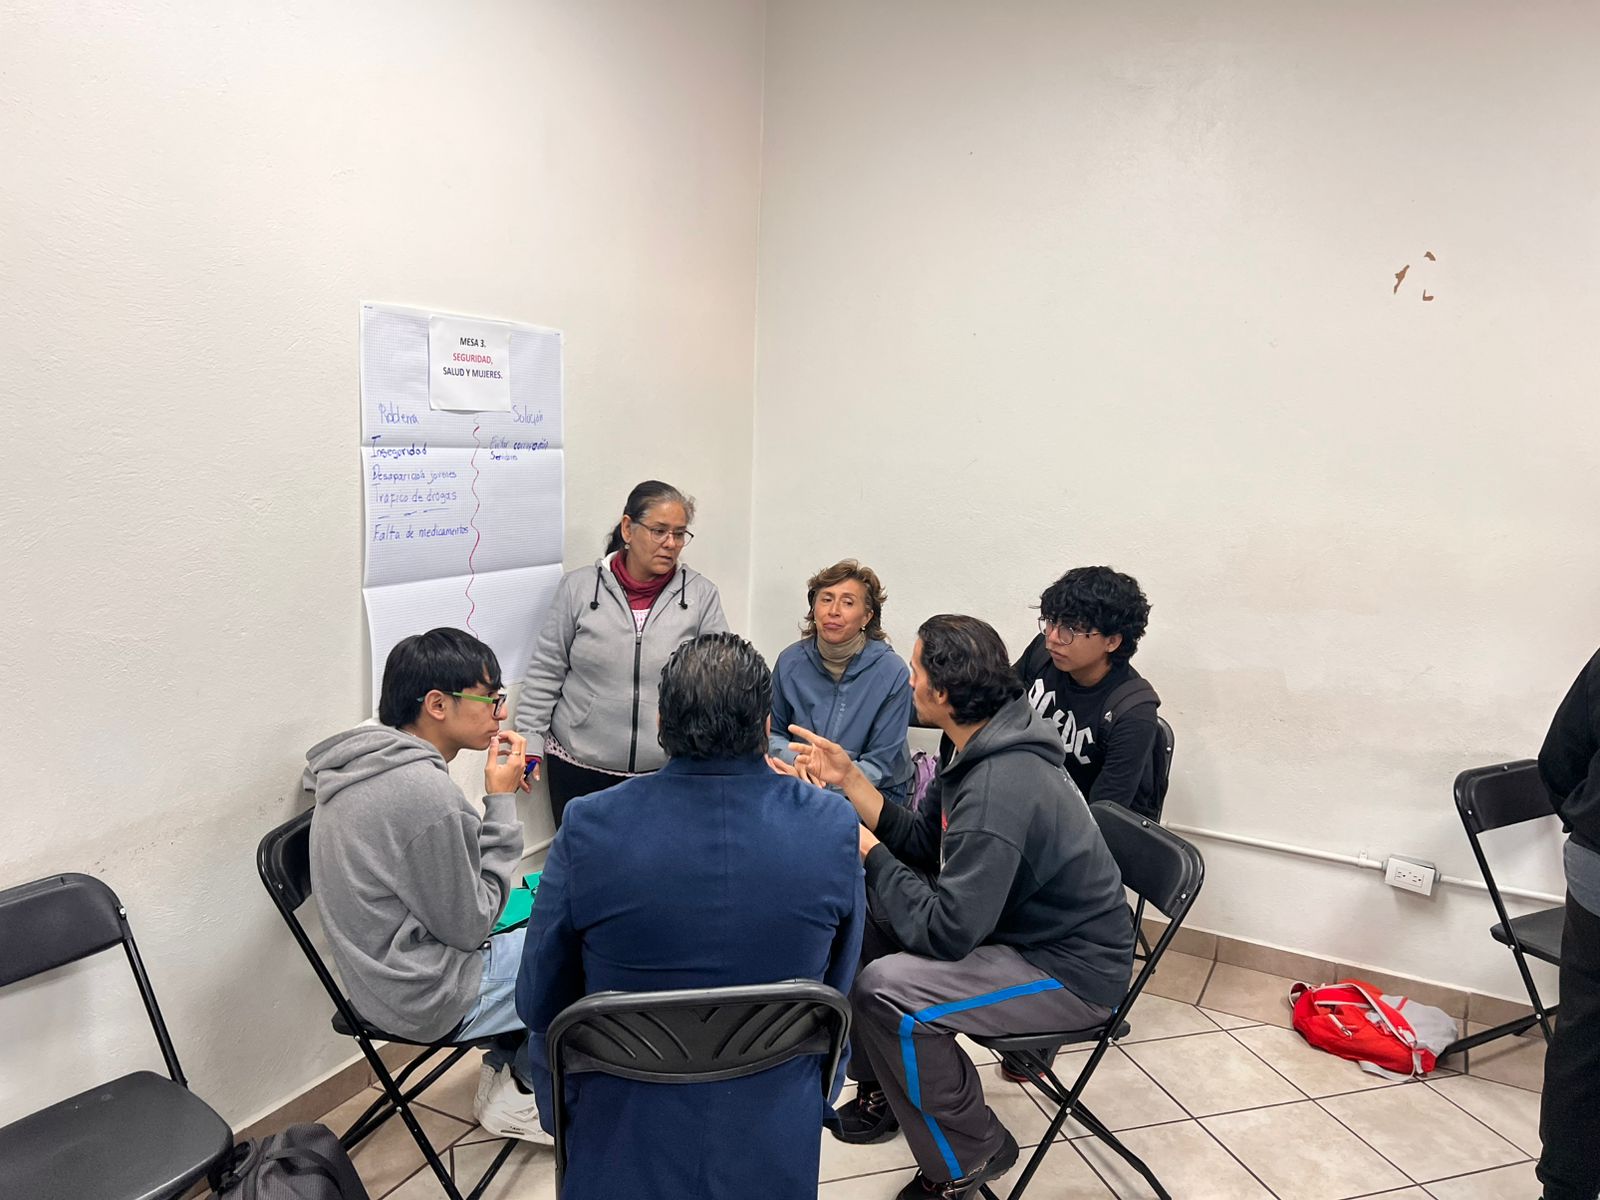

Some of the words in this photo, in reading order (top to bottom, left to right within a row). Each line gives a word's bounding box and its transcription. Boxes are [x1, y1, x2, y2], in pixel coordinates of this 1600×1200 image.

[459, 337, 479, 347] MESA
[480, 339, 487, 348] 3.
[452, 352, 494, 365] SEGURIDAD,
[442, 366, 465, 377] SALUD
[466, 369, 471, 377] Y
[472, 369, 503, 380] MUJERES.
[411, 488, 423, 503] de
[426, 488, 457, 504] drogas
[373, 523, 400, 542] Falta
[405, 525, 414, 539] de
